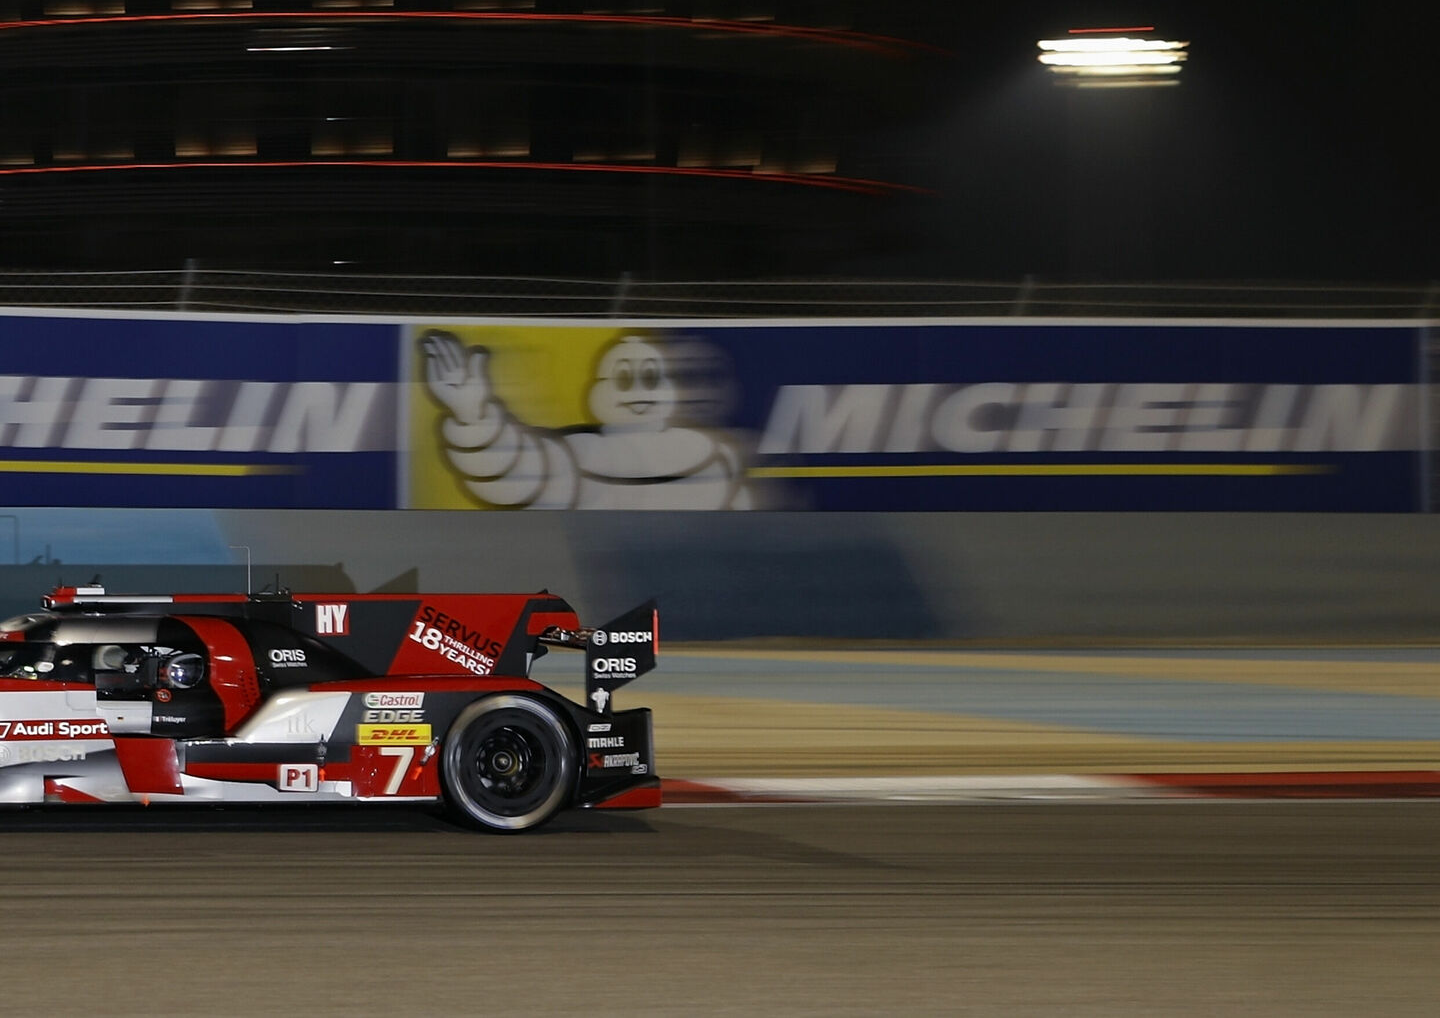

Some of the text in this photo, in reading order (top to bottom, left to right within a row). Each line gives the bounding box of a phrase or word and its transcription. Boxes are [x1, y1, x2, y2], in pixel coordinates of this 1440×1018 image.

[757, 382, 1403, 453] MICHELIN
[316, 604, 347, 633] HY
[420, 606, 502, 659] SERVUS
[610, 631, 652, 643] BOSCH
[409, 621, 494, 667] 18 THRILLING
[269, 649, 306, 662] ORIS
[440, 643, 491, 676] YEARS!
[593, 658, 637, 672] ORIS
[380, 694, 419, 706] Castrol
[363, 710, 425, 723] EDGE
[13, 722, 108, 737] Audi Sport
[371, 729, 419, 740] DHL
[588, 736, 624, 748] MAHLE
[19, 744, 87, 762] BOSCH
[286, 768, 312, 788] P1
[379, 747, 414, 795] 7
